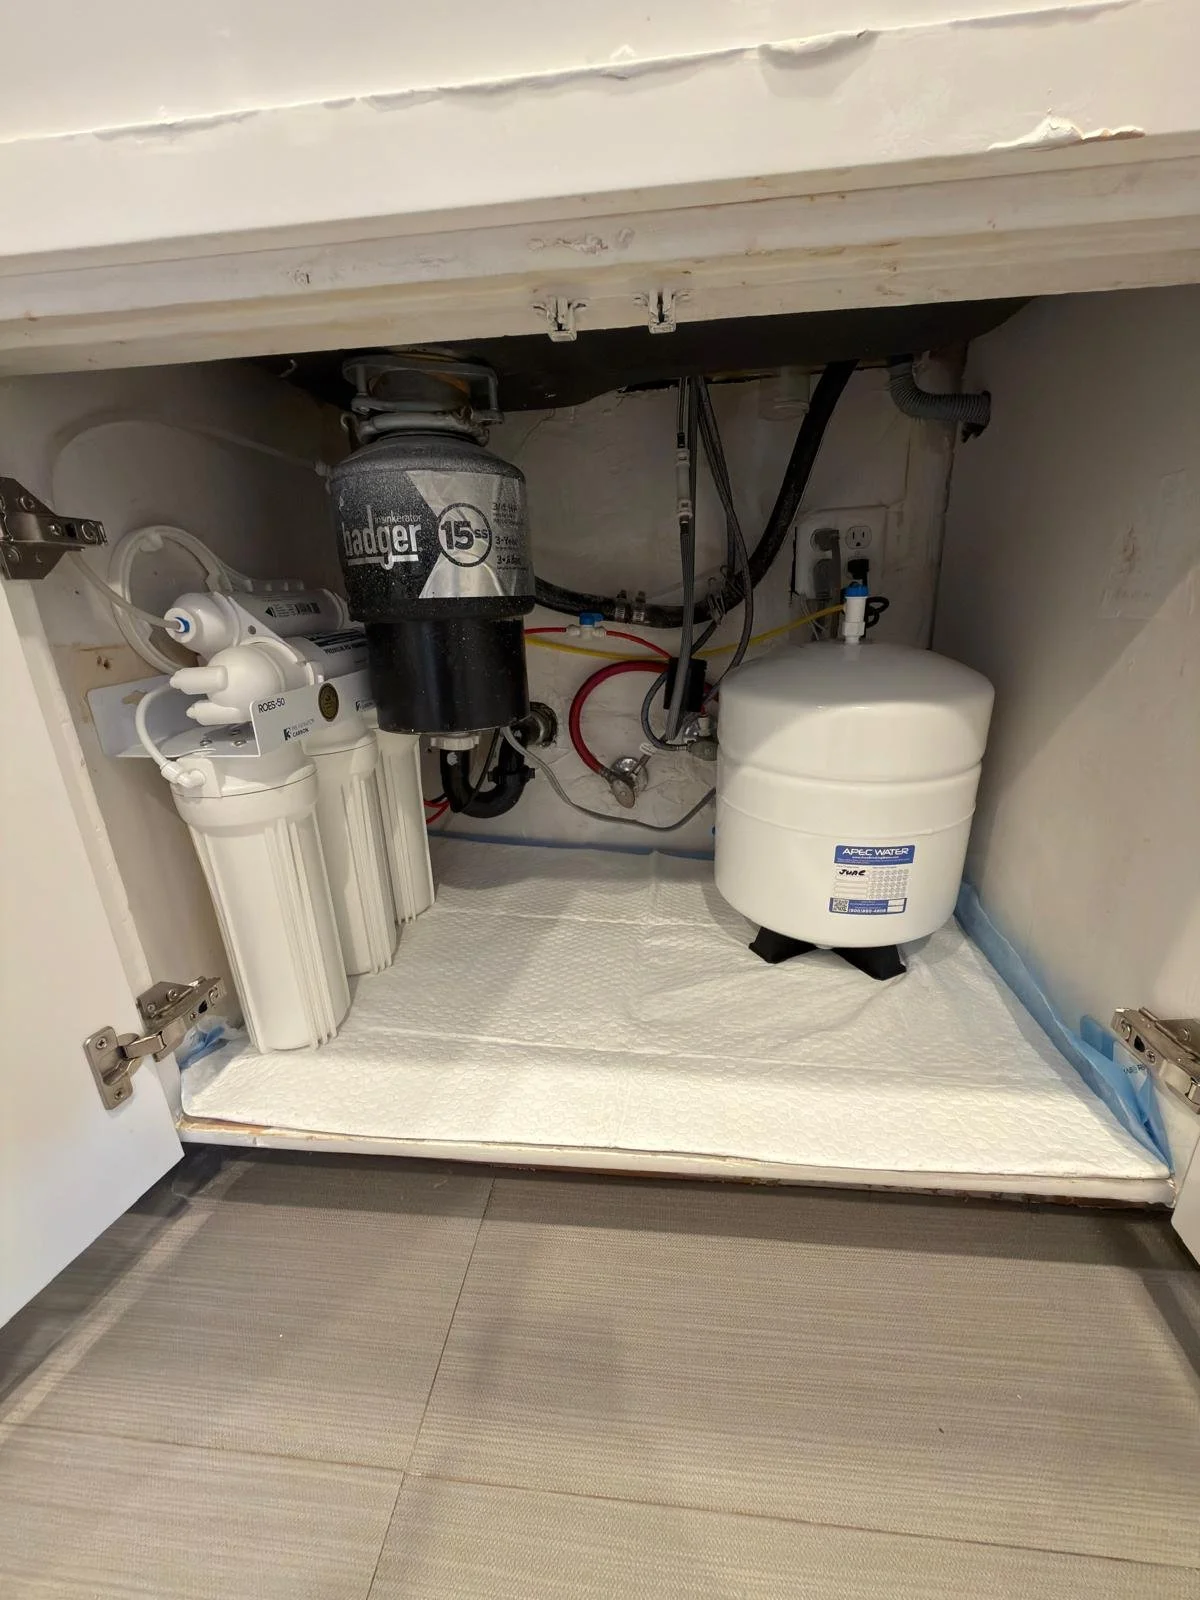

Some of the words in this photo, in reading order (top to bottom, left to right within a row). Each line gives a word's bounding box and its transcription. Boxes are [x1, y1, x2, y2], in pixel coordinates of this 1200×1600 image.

[341, 504, 422, 571] badger
[257, 697, 286, 714] ROES-50
[842, 848, 873, 856] APEC
[874, 847, 909, 856] WATER
